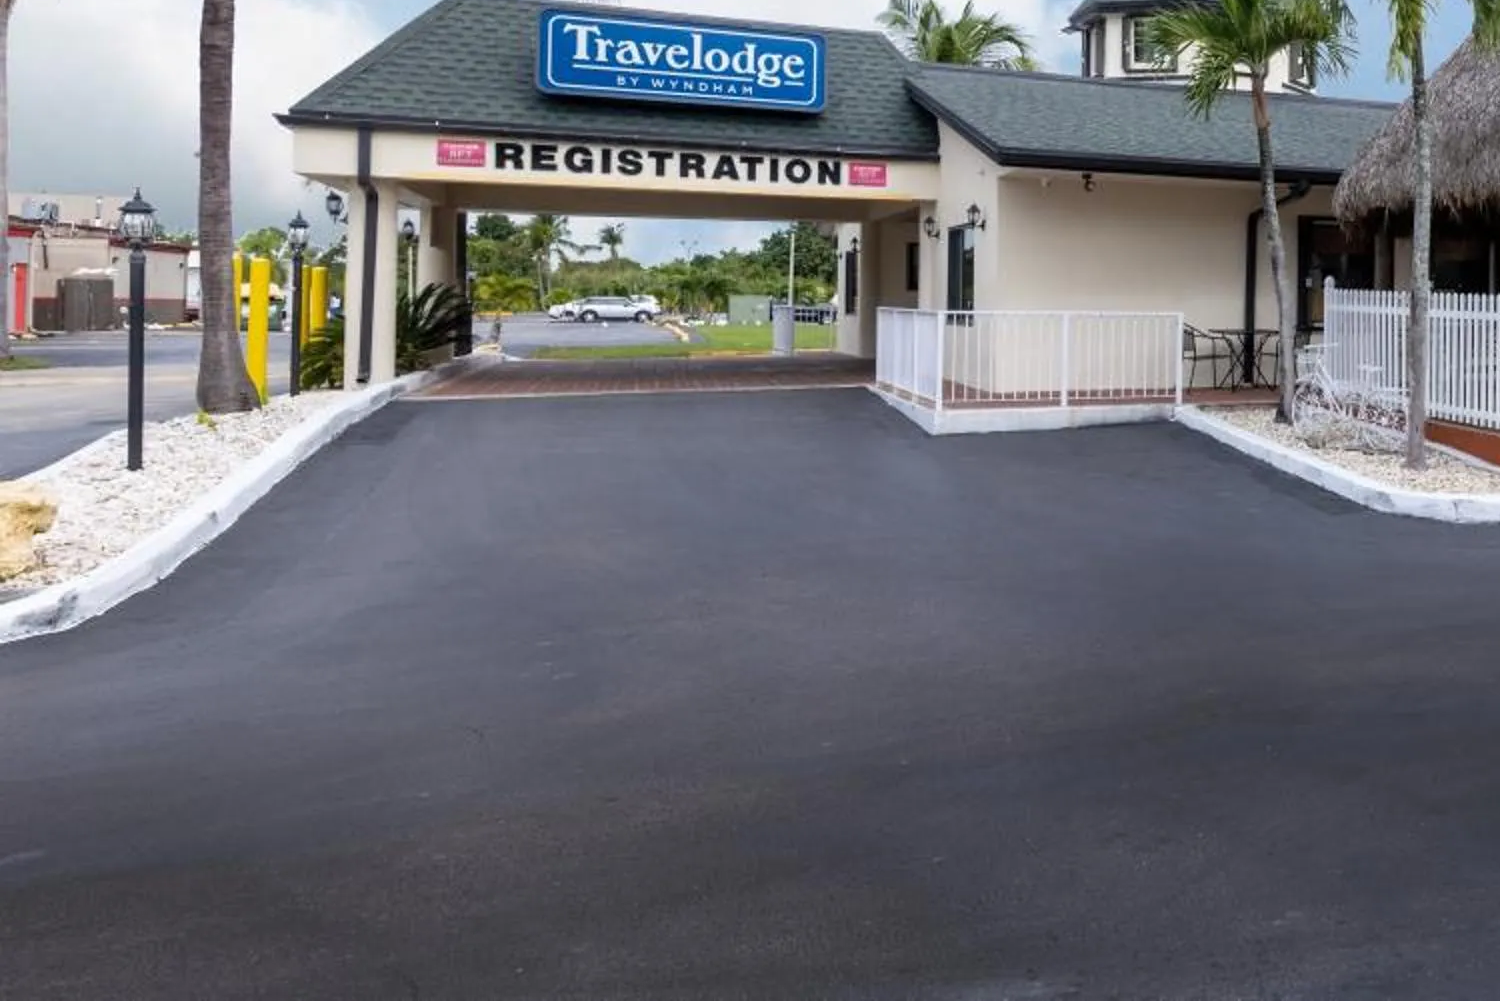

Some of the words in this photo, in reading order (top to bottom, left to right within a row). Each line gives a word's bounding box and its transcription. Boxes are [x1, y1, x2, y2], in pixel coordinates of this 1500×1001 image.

[563, 22, 806, 88] Travelodge
[616, 75, 640, 86] BY
[651, 77, 754, 96] WYNDHAM
[494, 142, 842, 186] REGISTRATION
